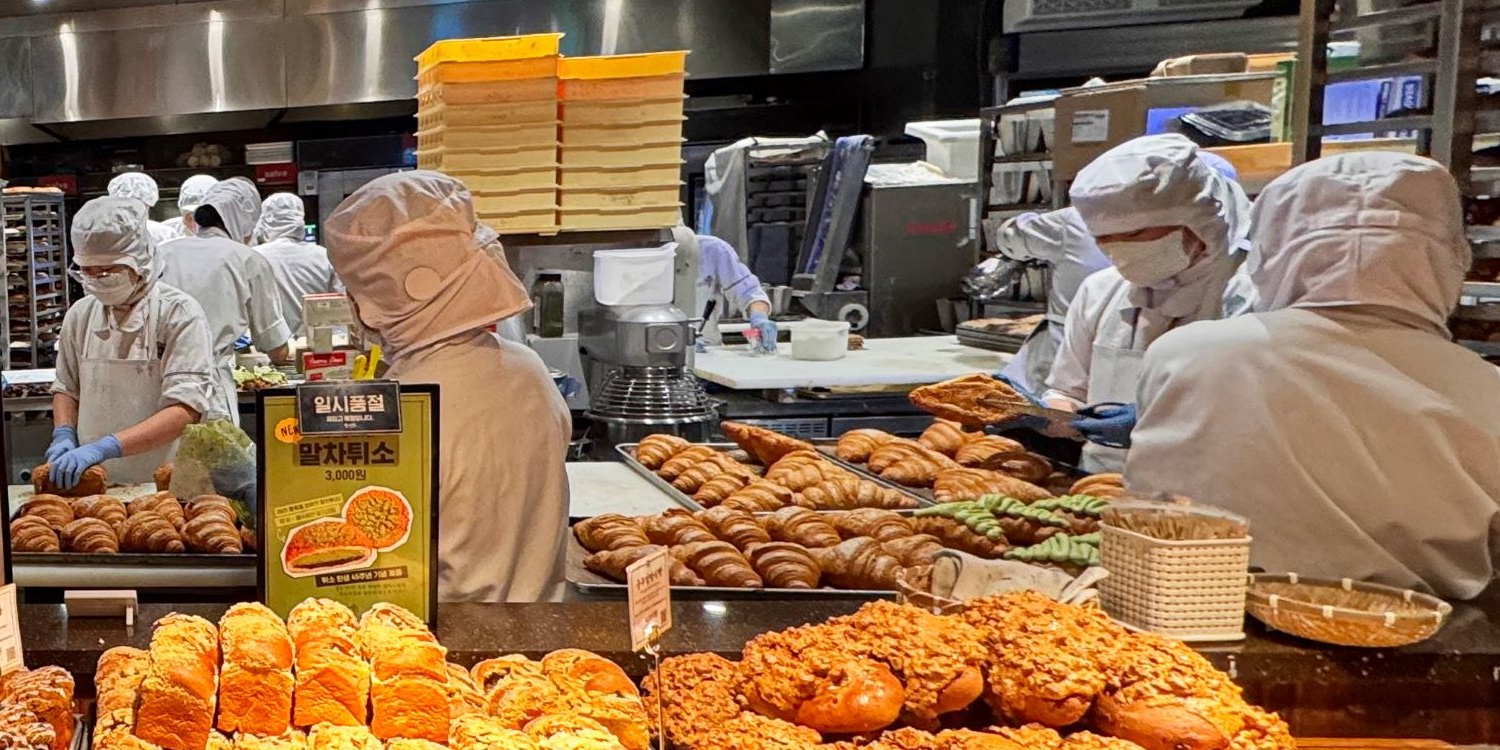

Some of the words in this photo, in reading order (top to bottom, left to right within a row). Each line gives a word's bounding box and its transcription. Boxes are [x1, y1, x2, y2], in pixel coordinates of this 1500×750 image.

[314, 394, 385, 414] 일시품절
[298, 442, 395, 467] 말차튀소
[325, 469, 366, 481] 3,000원
